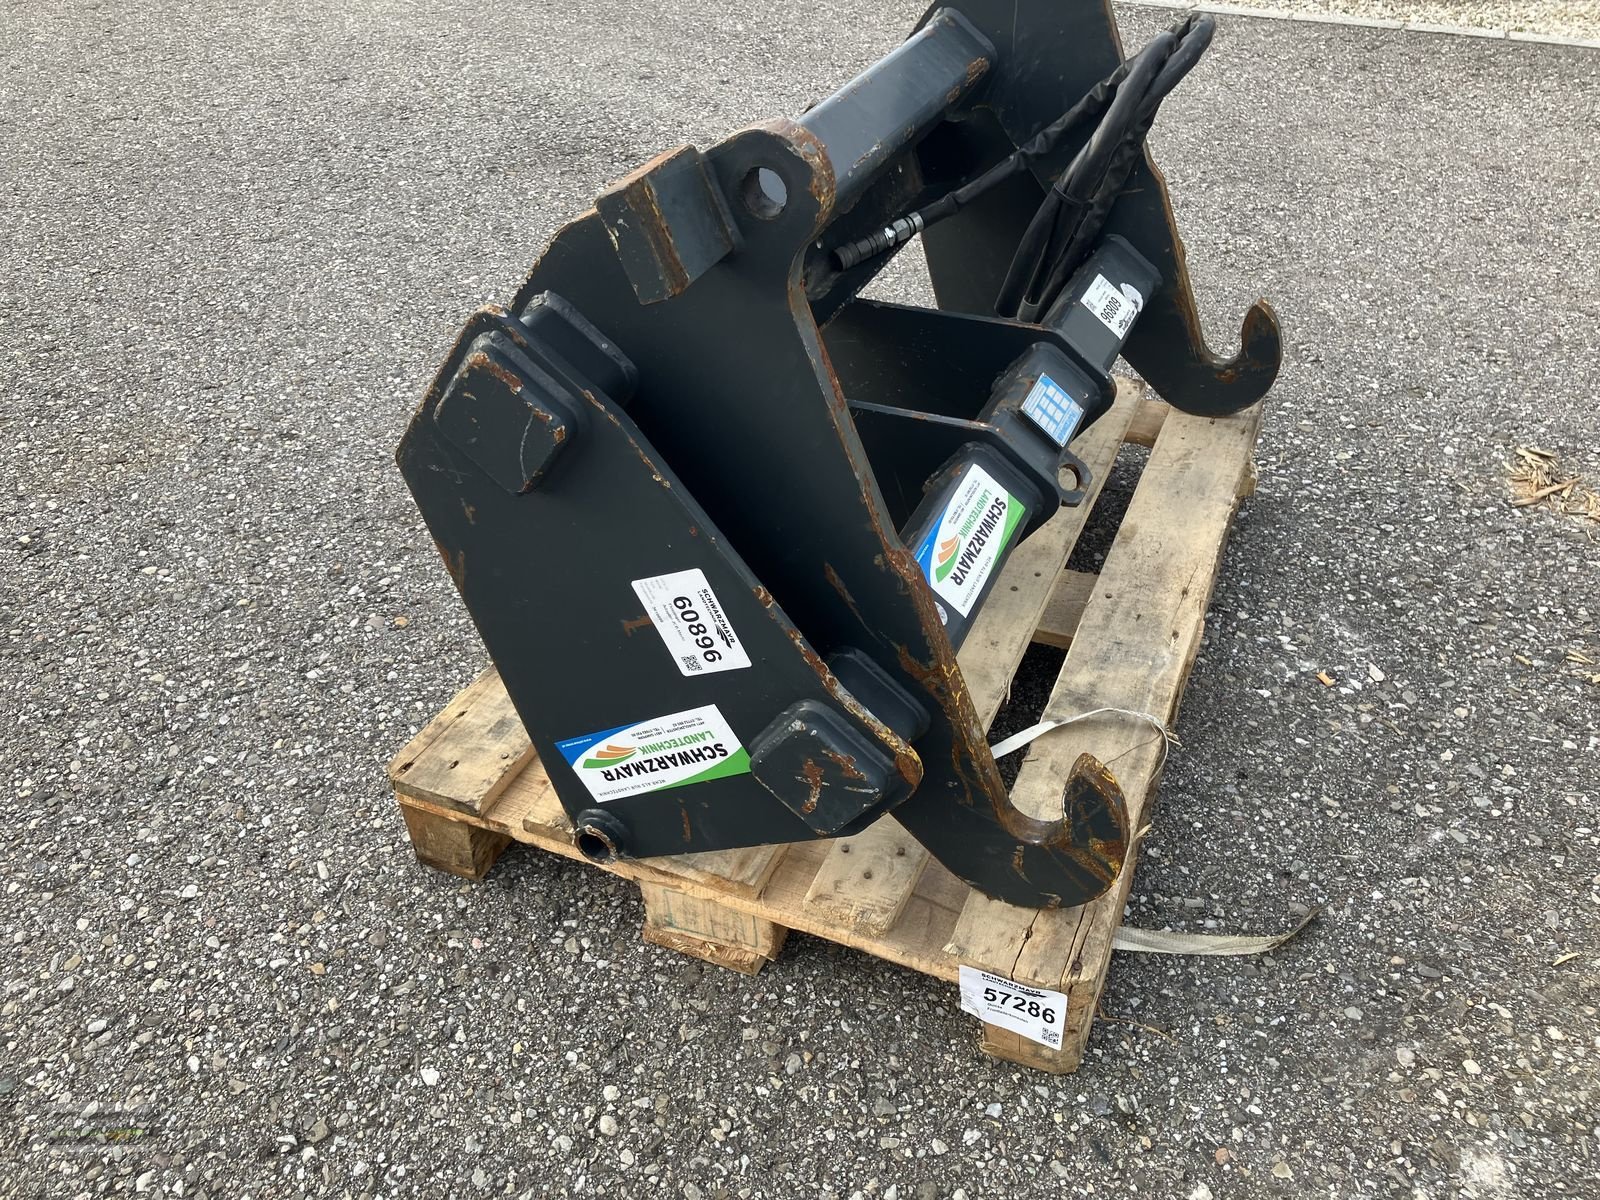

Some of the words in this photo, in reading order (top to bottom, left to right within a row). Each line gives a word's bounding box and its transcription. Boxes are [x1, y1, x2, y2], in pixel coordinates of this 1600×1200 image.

[1101, 297, 1119, 324] 60896
[958, 489, 992, 540] LANDTECHNIK
[950, 497, 1006, 586] SCHWARZMAYR
[696, 590, 717, 622] LANDTECHNIK
[701, 588, 736, 643] SCHWARZMAYR
[673, 596, 722, 663] 60896
[637, 730, 714, 755] LANDTECHNIK
[600, 743, 728, 781] SCHWARZMAYR
[981, 973, 1040, 995] SCHWARZMAYR
[983, 987, 1055, 1024] 57286
